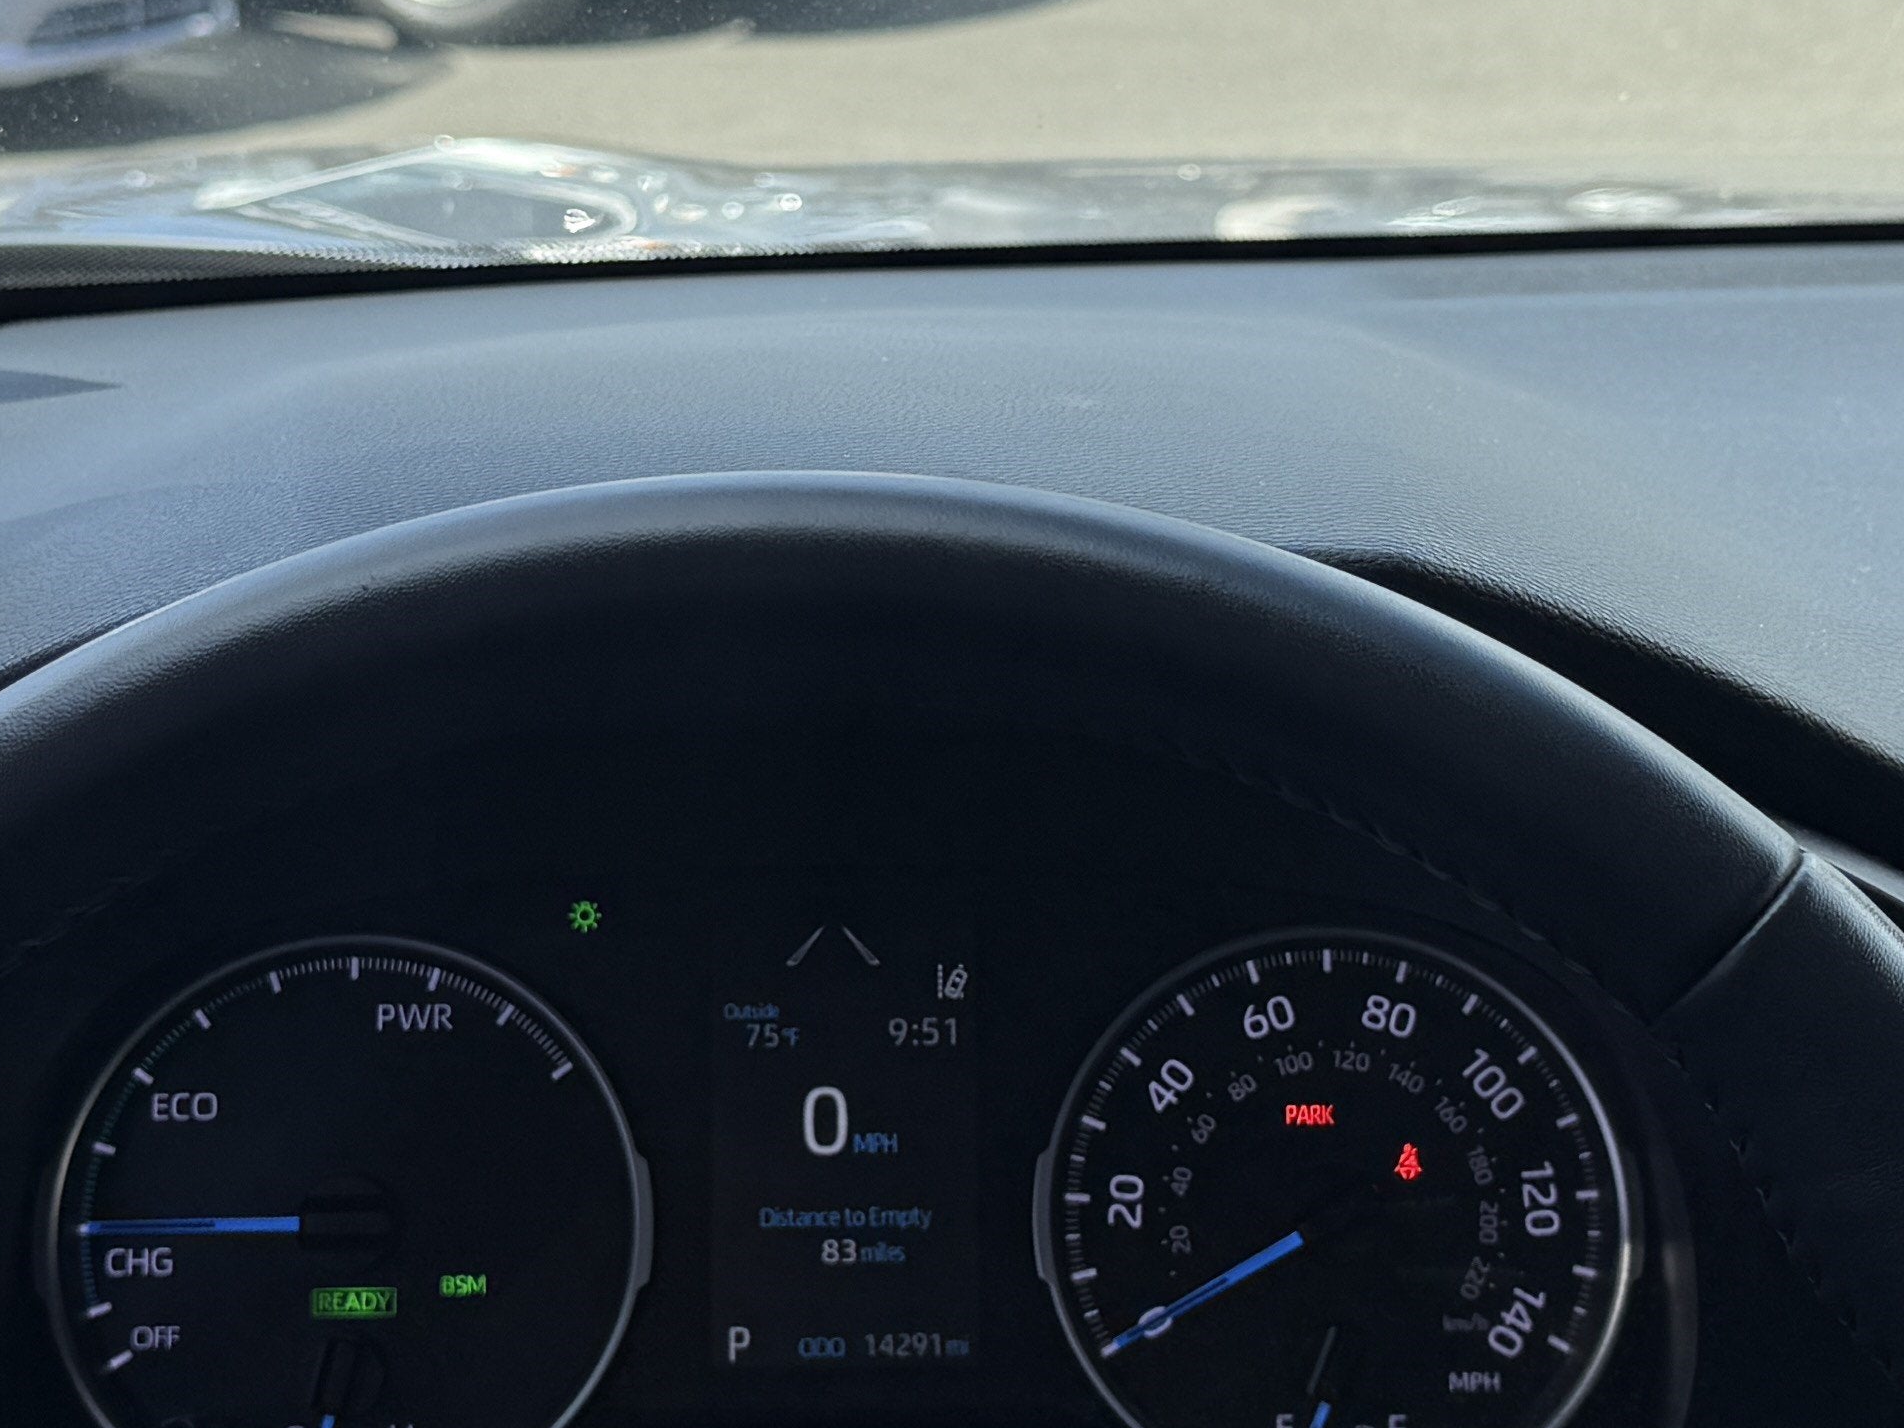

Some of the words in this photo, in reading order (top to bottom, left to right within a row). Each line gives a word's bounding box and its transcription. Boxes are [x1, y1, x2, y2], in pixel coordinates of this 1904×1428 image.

[376, 1003, 453, 1032] PWR
[723, 1003, 780, 1020] Outside
[1243, 995, 1295, 1039] 60
[1361, 994, 1417, 1038] 80
[888, 1016, 957, 1046] 9:51
[1274, 1051, 1314, 1077] 100
[1333, 1049, 1371, 1073] 120
[1148, 1058, 1194, 1112] 40
[1228, 1074, 1257, 1102] 80
[1388, 1064, 1425, 1094] 140
[1460, 1048, 1524, 1120] 100
[151, 1092, 218, 1122] ECO
[803, 1086, 848, 1156] 0
[853, 1132, 898, 1154] MPH
[1285, 1104, 1335, 1126] PARK
[1434, 1096, 1467, 1134] 160
[1192, 1114, 1216, 1145] 60
[1170, 1167, 1193, 1197] 40
[1107, 1174, 1145, 1229] 20
[1521, 1161, 1561, 1237] 120
[759, 1207, 841, 1229] Distance
[843, 1207, 867, 1228] to
[868, 1205, 932, 1230] Empty
[1478, 1199, 1497, 1245] 200
[821, 1238, 857, 1264] 83
[1171, 1224, 1192, 1255] 20
[105, 1246, 174, 1277] CHG
[441, 1274, 487, 1296] BSM
[316, 1290, 392, 1311] READY
[1487, 1287, 1546, 1358] 140
[130, 1325, 181, 1352] OFF
[728, 1326, 751, 1362] P
[864, 1331, 942, 1357] 14291
[1448, 1371, 1501, 1392] MPH
